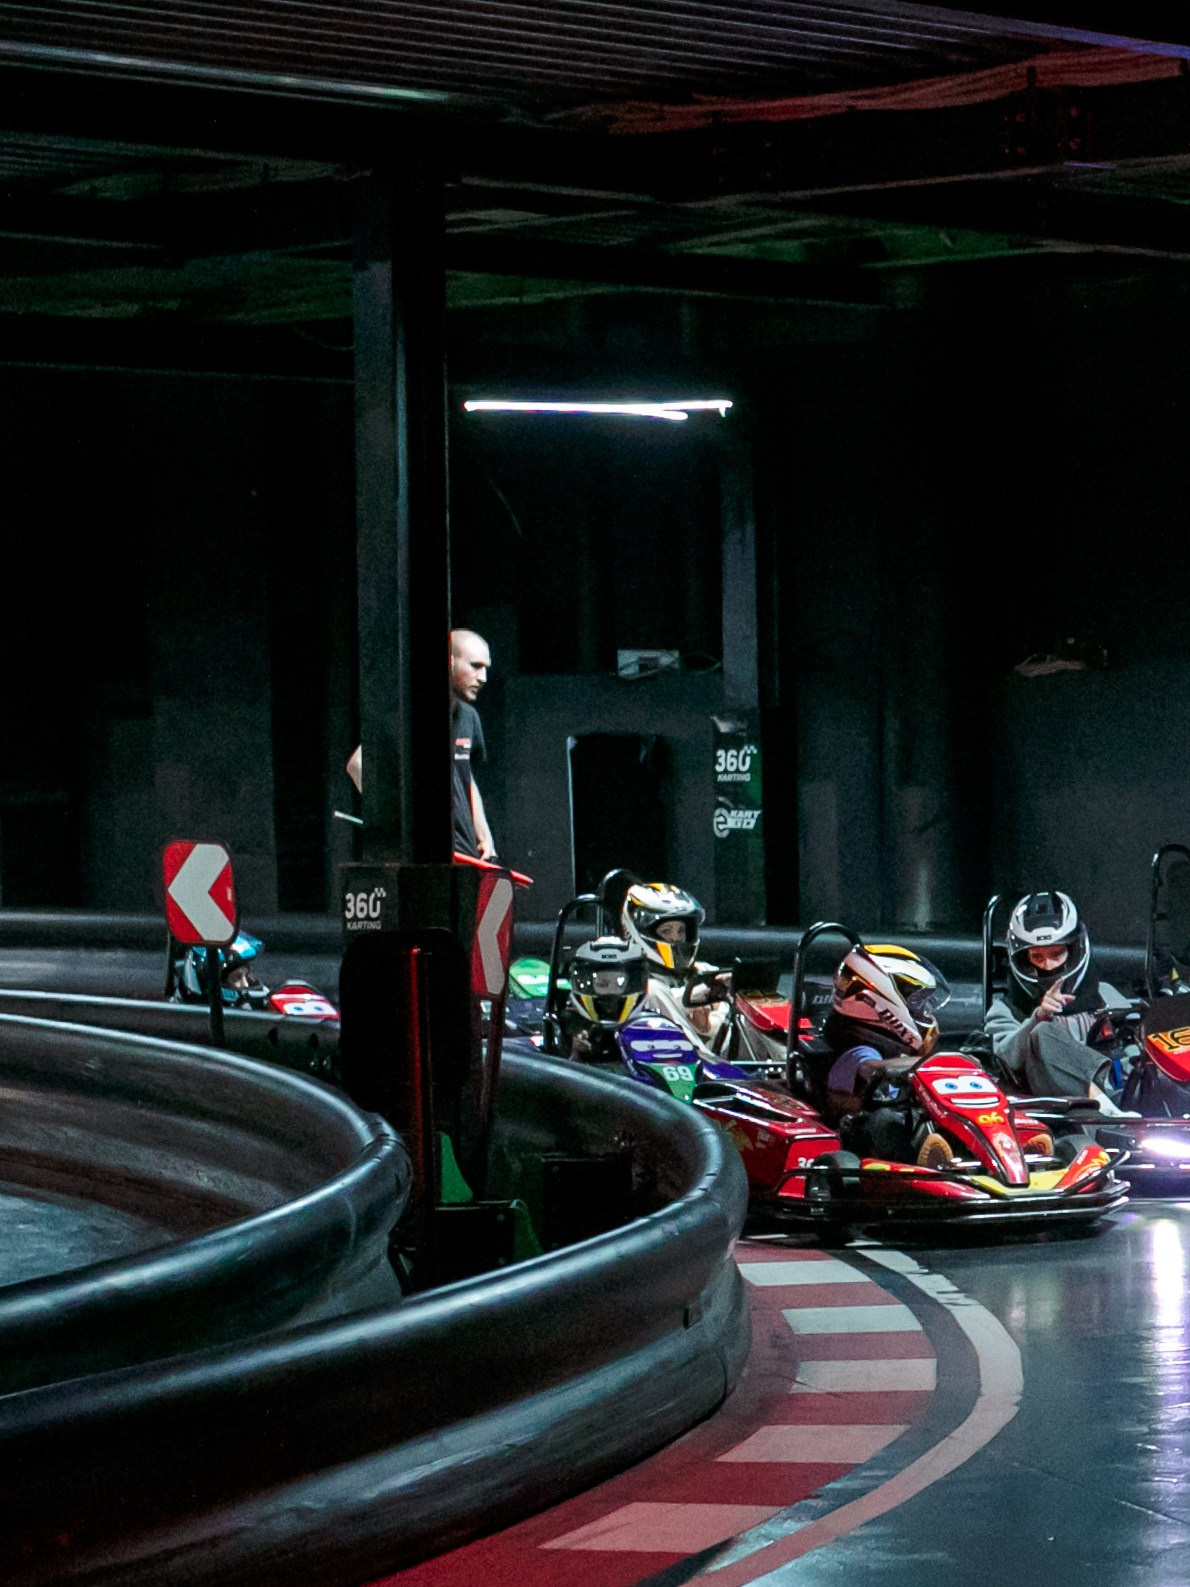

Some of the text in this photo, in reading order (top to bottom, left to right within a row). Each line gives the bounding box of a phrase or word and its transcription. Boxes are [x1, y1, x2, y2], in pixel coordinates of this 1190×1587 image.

[717, 773, 751, 782] KARTING
[346, 921, 382, 930] KARTING
[662, 1066, 694, 1082] 69
